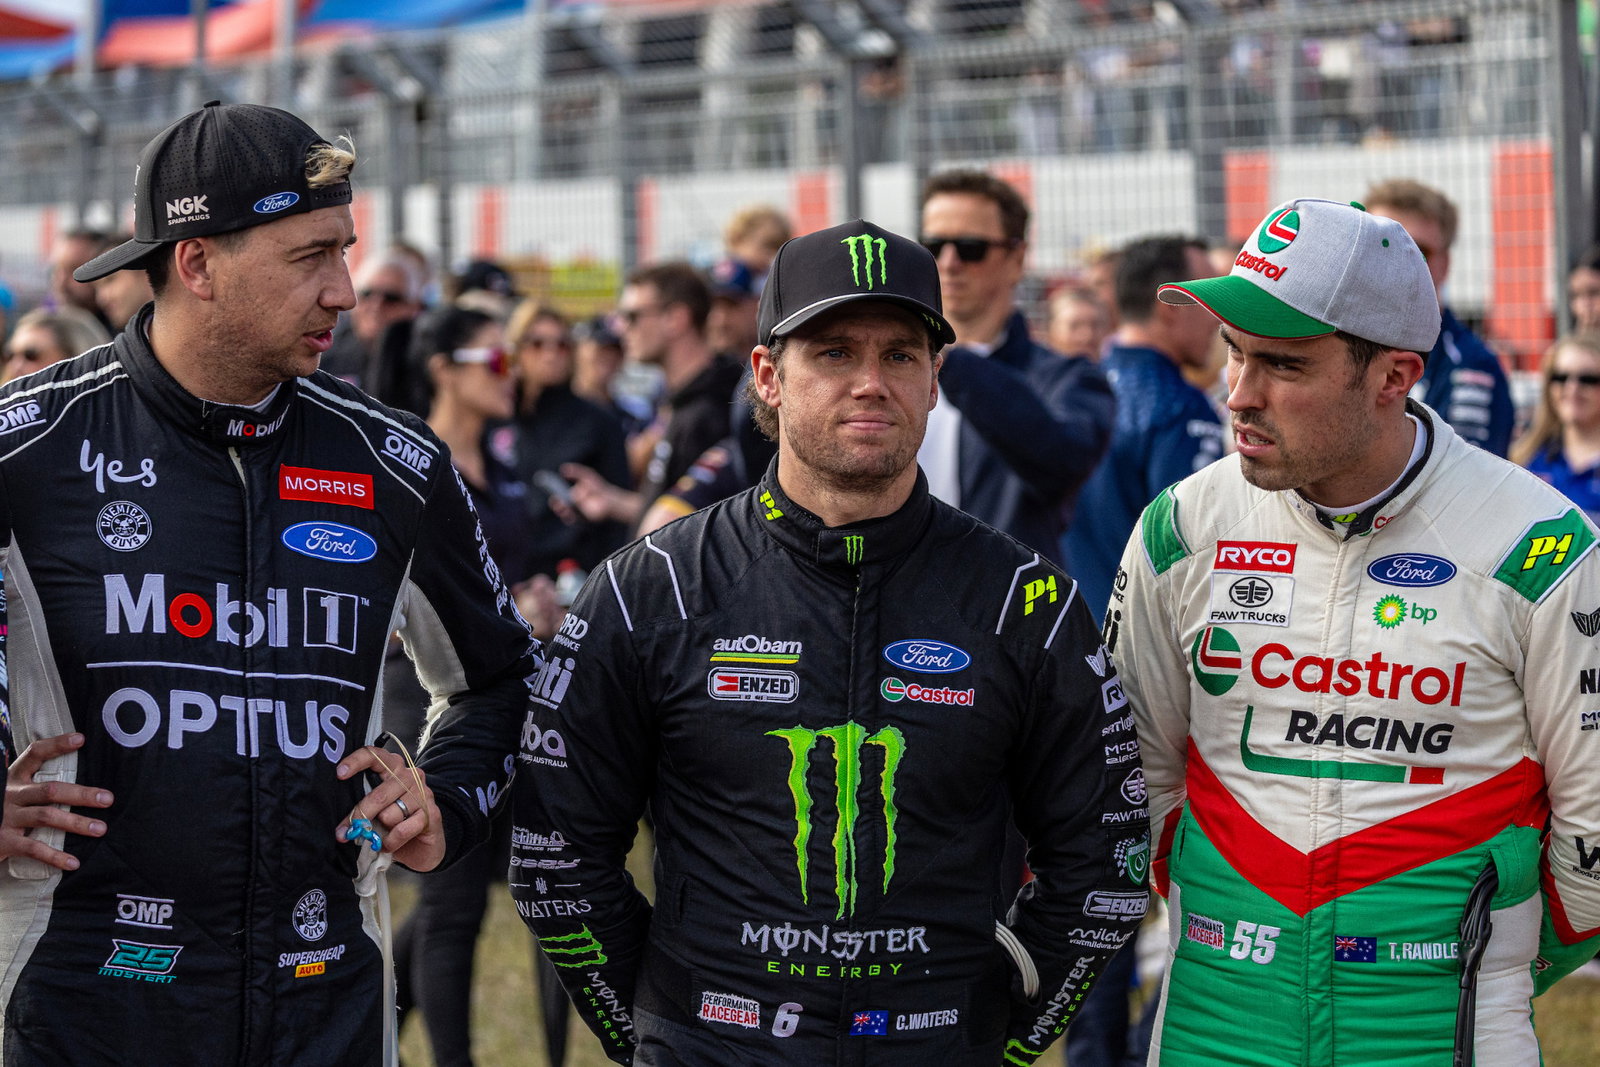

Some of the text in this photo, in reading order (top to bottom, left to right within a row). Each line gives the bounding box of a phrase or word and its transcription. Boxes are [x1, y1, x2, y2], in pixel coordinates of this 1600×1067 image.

[166, 194, 209, 218] NGK
[263, 195, 291, 212] Ford
[168, 213, 211, 226] SPARK PLUGS
[1235, 251, 1288, 281] Castrol
[80, 439, 157, 493] yes
[384, 435, 431, 473] OMP
[285, 476, 366, 497] MORRIS
[101, 504, 147, 528] CHEMICAL
[111, 535, 141, 548] GUYS
[305, 528, 357, 556] Ford
[1521, 532, 1574, 571] P1
[1218, 546, 1292, 566] RYCO
[1386, 557, 1440, 581] Ford
[1023, 575, 1058, 616] P1
[104, 574, 289, 648] Mobil
[320, 595, 342, 645] 1
[1210, 611, 1287, 624] FAW TRUCKS
[1411, 602, 1438, 625] bp
[902, 643, 954, 669] Ford
[740, 676, 791, 694] ENZED
[1251, 642, 1467, 707] Castrol
[906, 683, 975, 707] Castrol
[102, 687, 350, 764] OPTUS
[1285, 710, 1454, 755] RACING
[532, 756, 568, 769] AUSTRALIA
[1102, 811, 1132, 823] FAW
[117, 899, 174, 924] OMP
[515, 899, 593, 919] WATERS
[303, 923, 324, 937] GUYS
[1187, 925, 1223, 948] RACEGEAR
[1229, 919, 1281, 965] 55
[110, 943, 177, 970] 25
[278, 943, 346, 969] SUPERCHEAP
[98, 966, 177, 984] MOSTERT
[298, 963, 323, 976] AUTO
[767, 961, 903, 979] ENERGY
[702, 1004, 758, 1025] RACEGEAR
[704, 994, 758, 1012] PERFORMANCE
[1054, 971, 1095, 1035] ENERGY
[583, 987, 626, 1047] ENERGY
[771, 1002, 804, 1038] 6
[896, 1008, 959, 1031] C.WATERS
